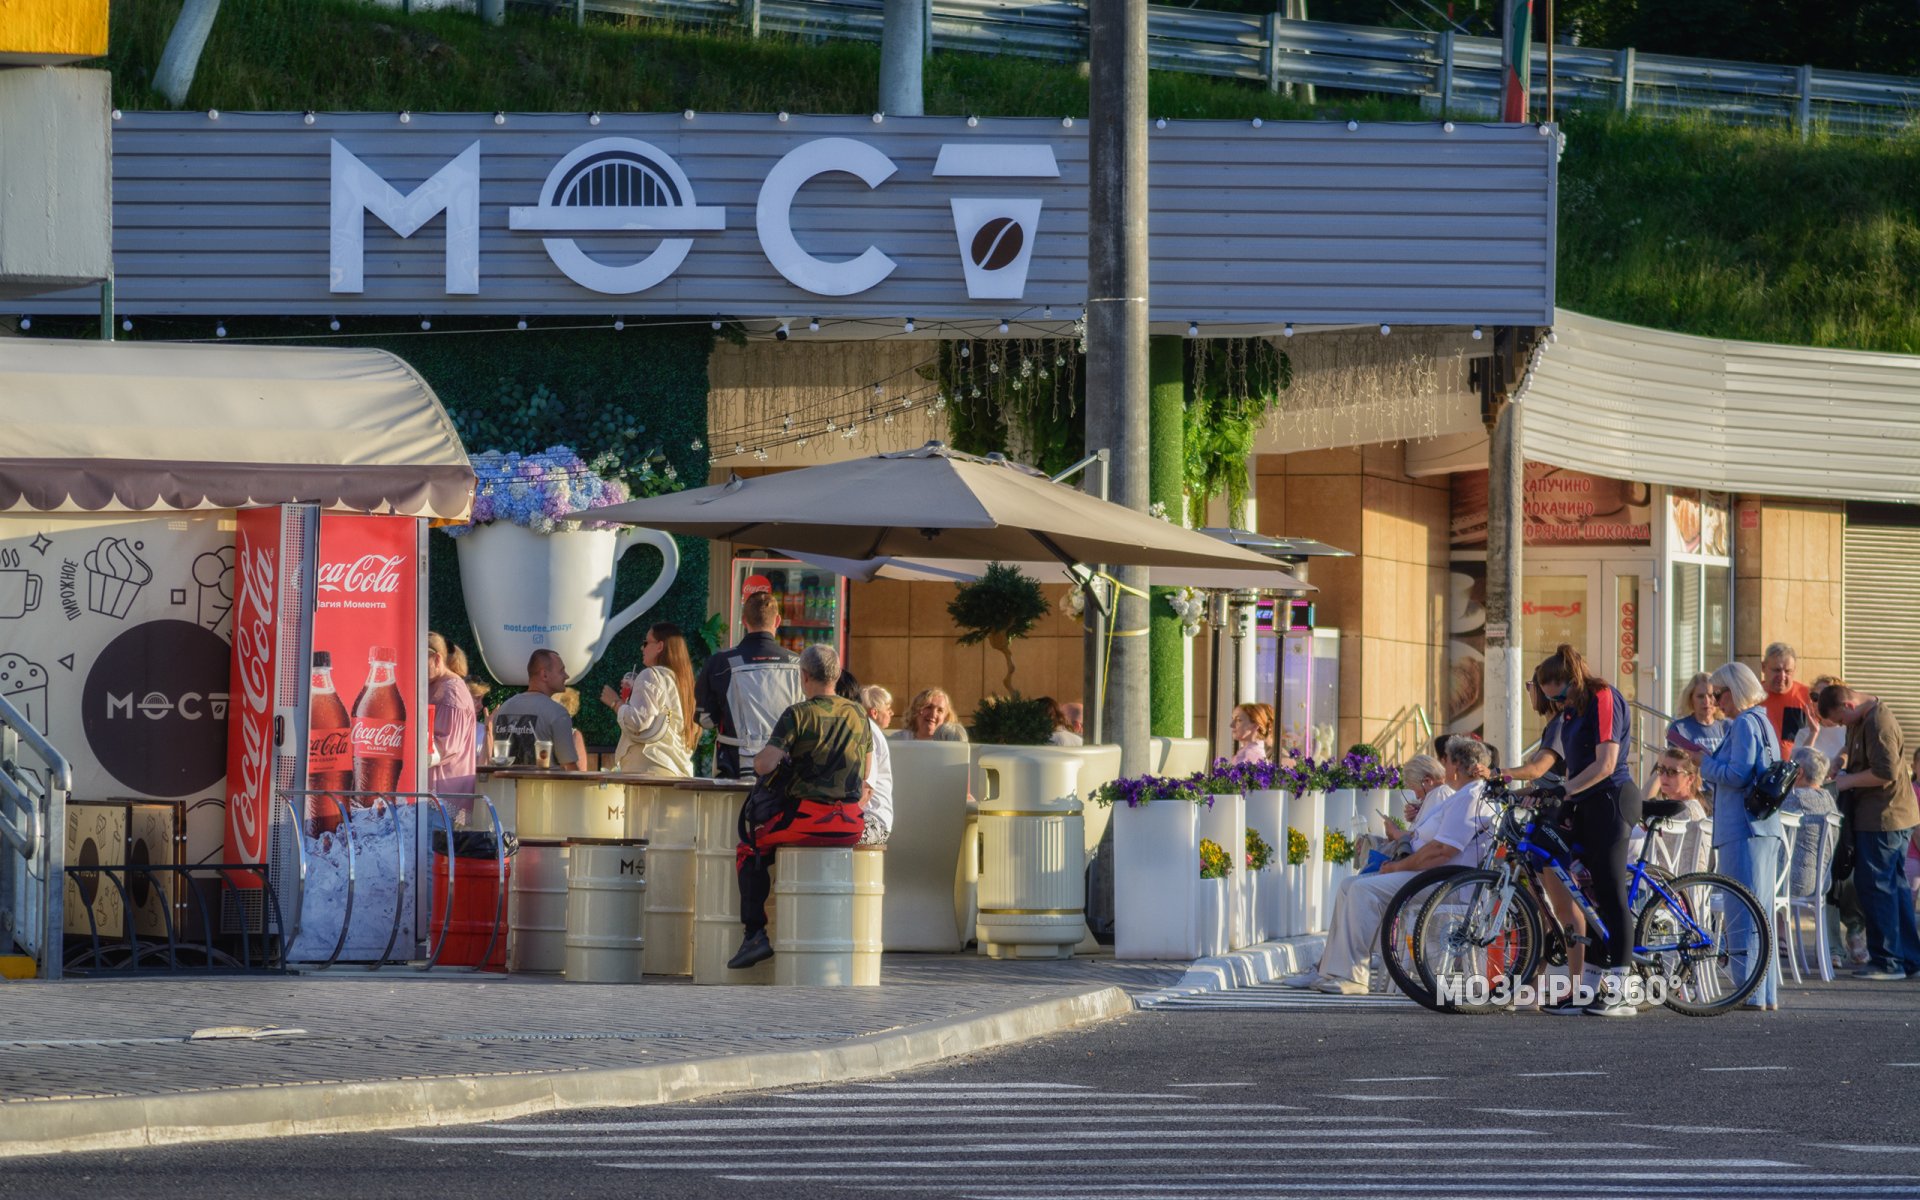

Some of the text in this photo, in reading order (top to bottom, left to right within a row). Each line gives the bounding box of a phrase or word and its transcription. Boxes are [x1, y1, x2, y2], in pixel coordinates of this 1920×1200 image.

[1524, 524, 1649, 538] ОРЯЧИЙ ШОКОЛАД
[318, 554, 407, 593] ca-Cola
[60, 557, 82, 621] ПИРОЖНОЕ
[317, 600, 387, 608] агия Момента
[231, 528, 274, 872] Coca-Cola
[310, 732, 349, 756] a-Cola
[351, 721, 405, 748] Coca-Cola
